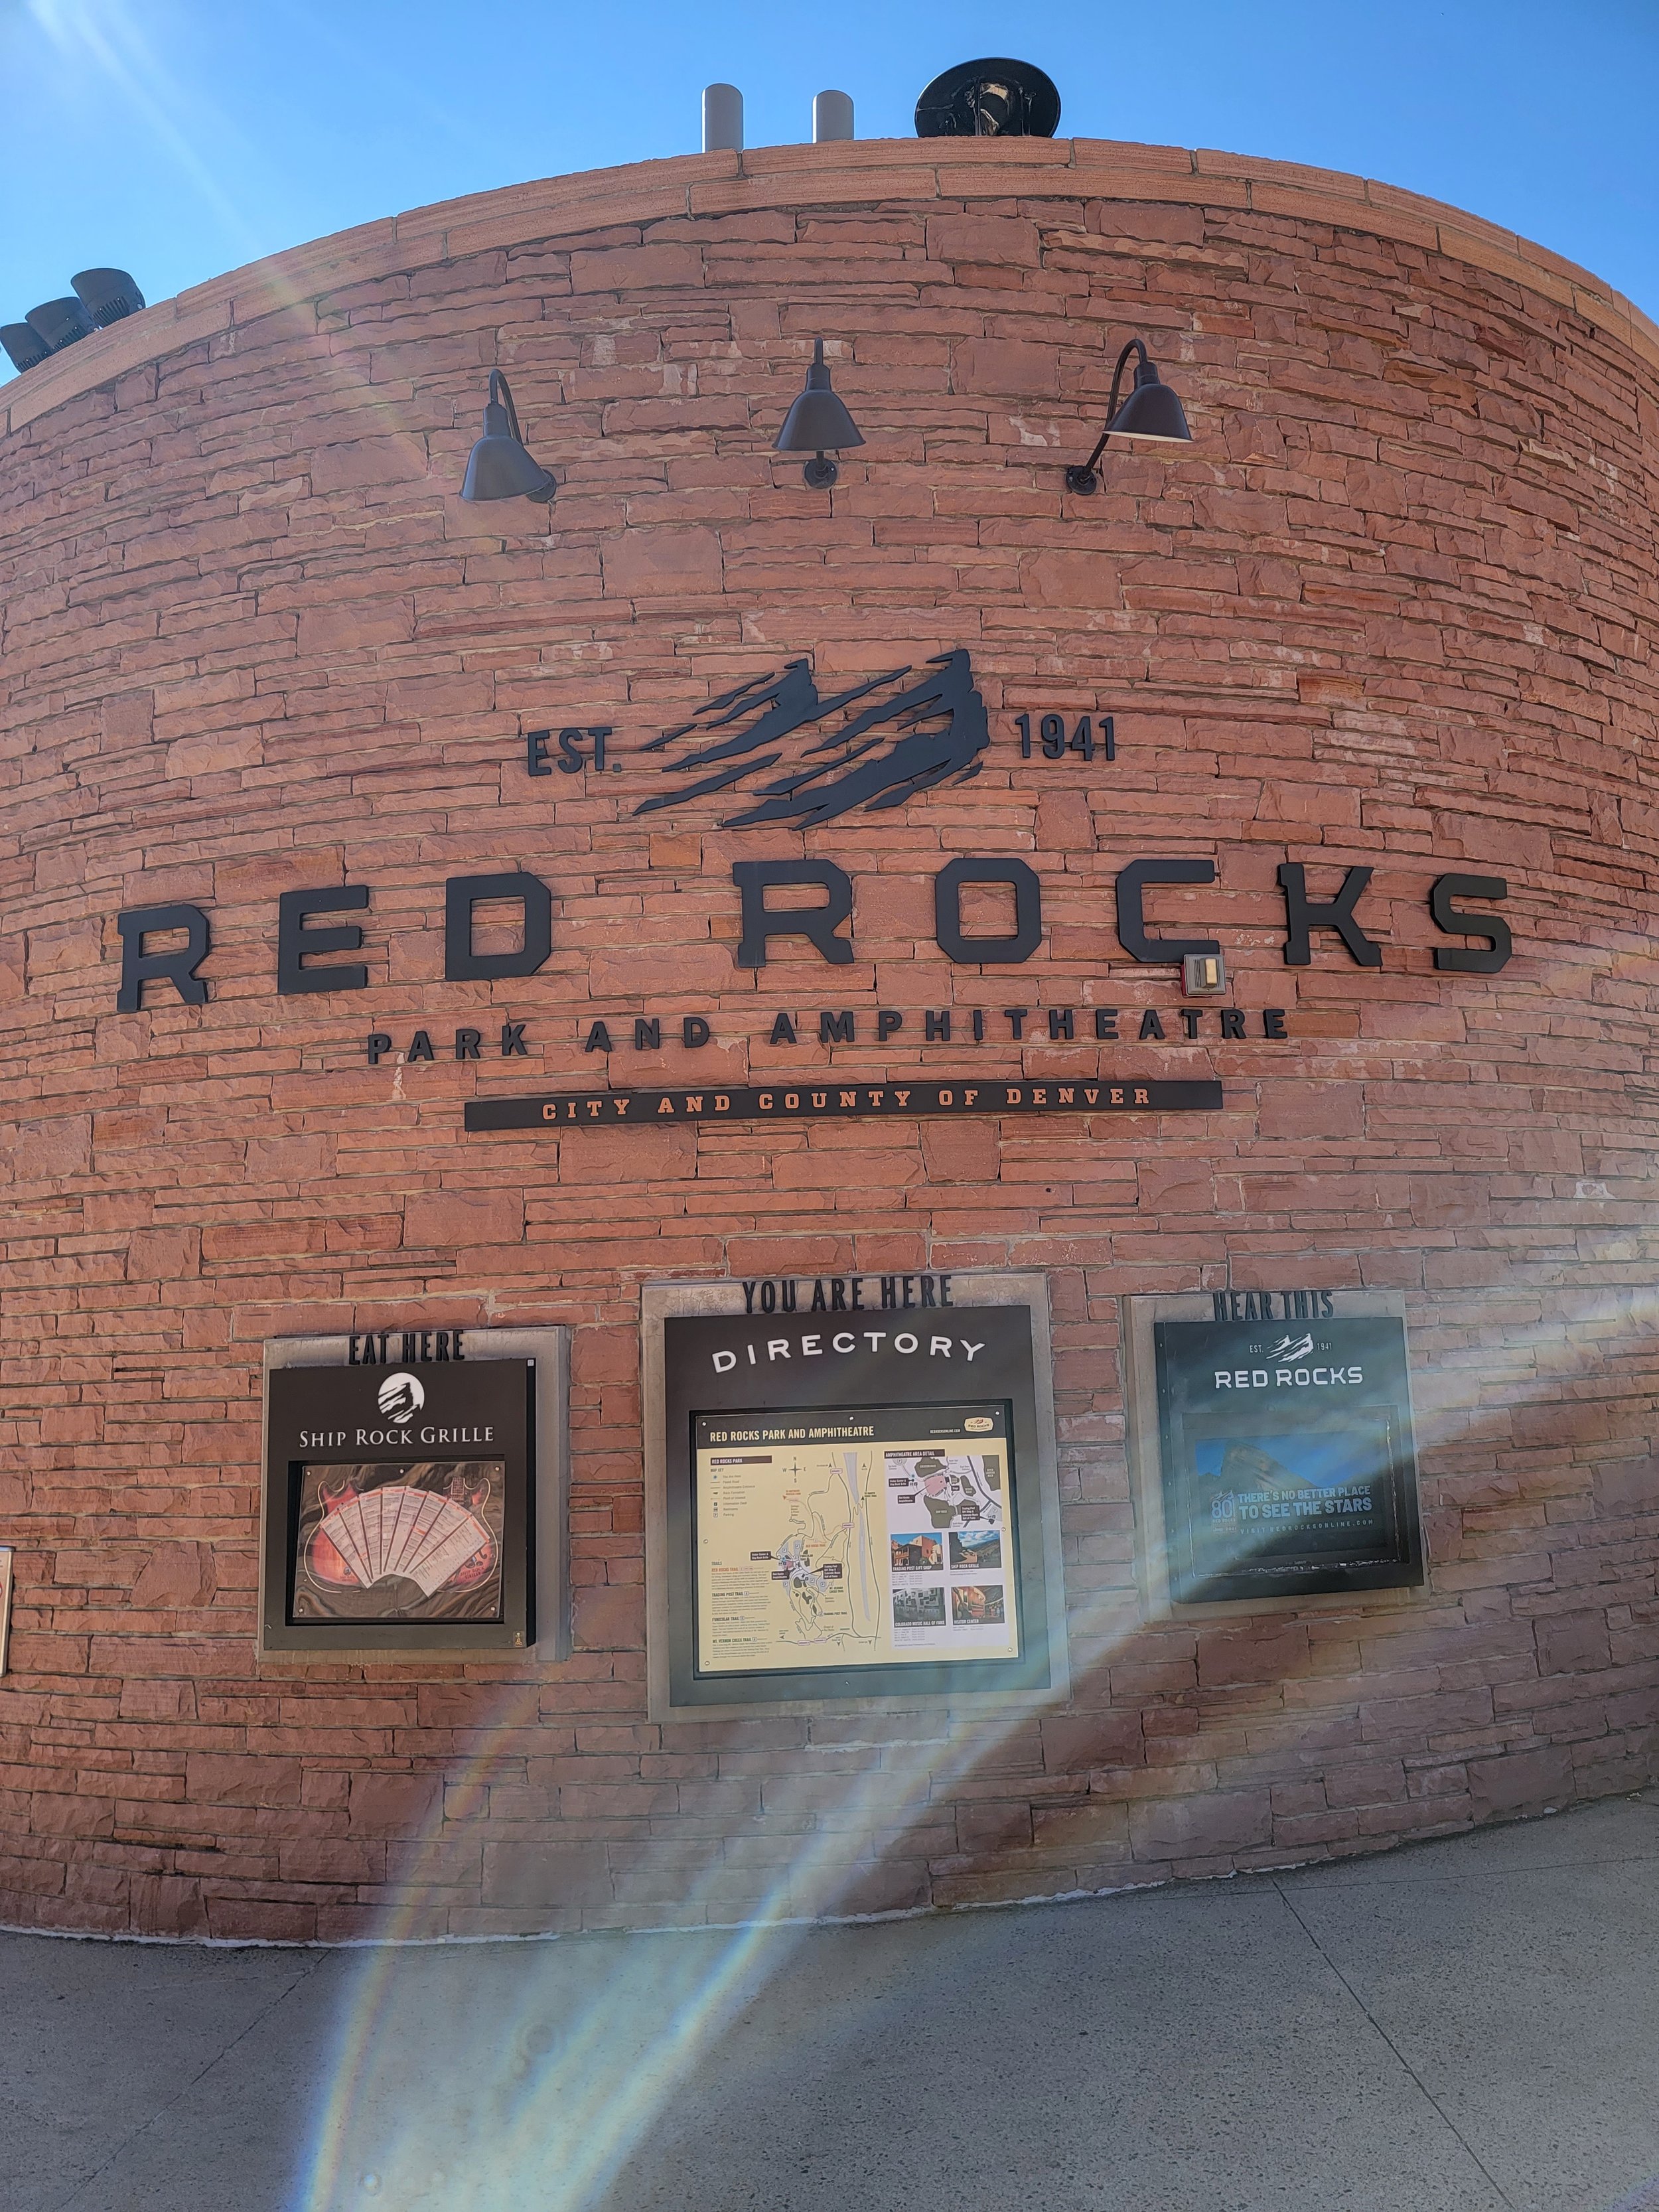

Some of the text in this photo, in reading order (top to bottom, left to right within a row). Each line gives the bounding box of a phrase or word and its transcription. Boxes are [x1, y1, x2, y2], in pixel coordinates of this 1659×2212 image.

[528, 713, 1116, 776] EST. 1941
[117, 857, 1512, 1013] RED ROCKS
[368, 1007, 1289, 1065] PARK AND AMPHITHEATRE
[542, 1087, 1149, 1120] CITY AND COUNTY OF DENVER
[742, 1274, 954, 1314] YOU ARE HERE
[1213, 1290, 1334, 1321] HEAR THIS
[348, 1329, 465, 1365] EAT HERE
[711, 1331, 986, 1374] DIRECTORY
[1250, 1342, 1333, 1353] EST. 1941
[1214, 1366, 1363, 1389] RED ROCKS
[710, 1426, 875, 1442] RED ROCKS PARK AND AMPHITHEATRE
[1238, 1485, 1371, 1504] THERE'S NO BETTER PLACE
[1238, 1497, 1372, 1520] TO SEE THE STARS
[1270, 1519, 1374, 1532] REDROCKSONLINE.COM
